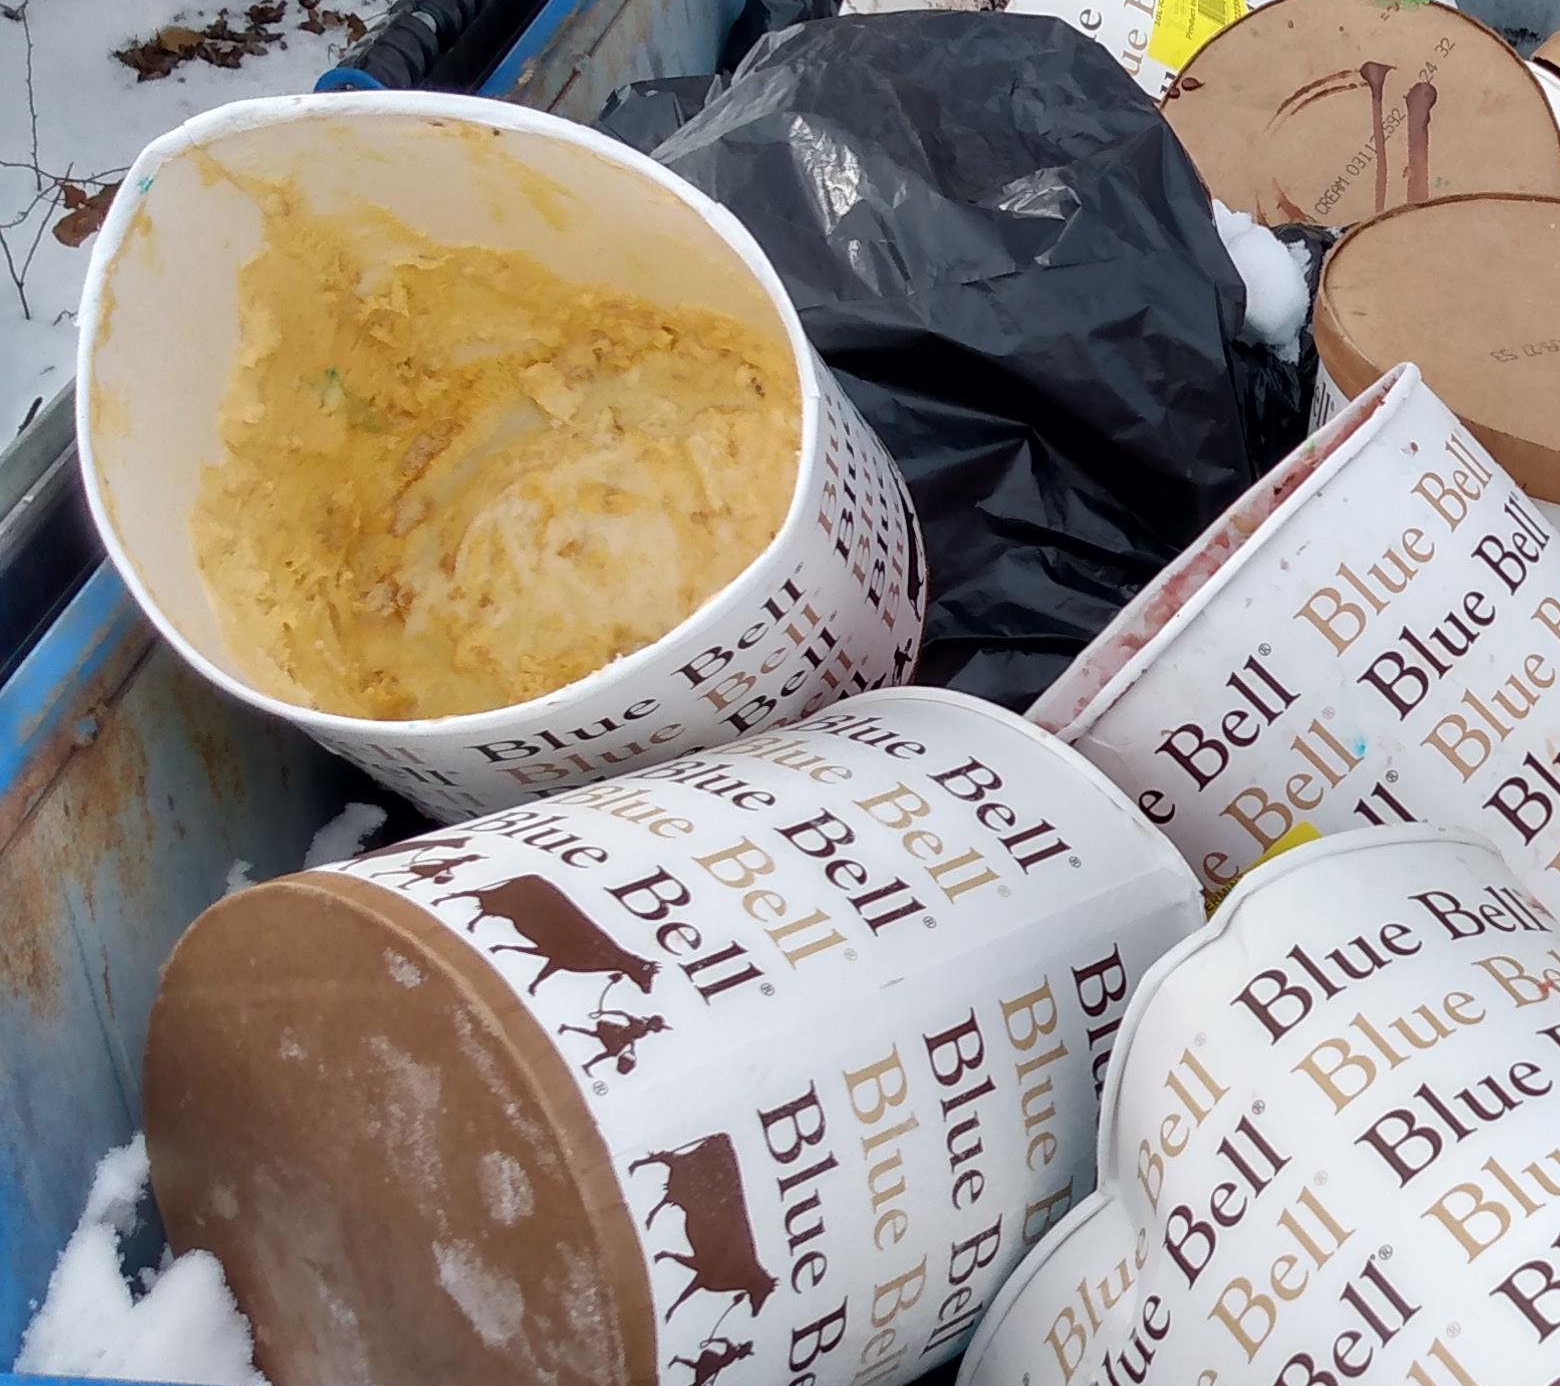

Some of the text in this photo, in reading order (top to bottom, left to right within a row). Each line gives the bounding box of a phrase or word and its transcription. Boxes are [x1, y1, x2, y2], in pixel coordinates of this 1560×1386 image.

[1121, 28, 1148, 78] ue
[1314, 176, 1350, 215] CREAM
[1346, 108, 1406, 177] 0311592
[1434, 37, 1456, 58] 32
[1294, 433, 1494, 657] Blue Bell
[1357, 497, 1551, 721] Blue Bell
[464, 578, 806, 763] Blue Bell
[497, 722, 687, 785] Blue
[698, 604, 820, 713] Bell
[720, 627, 839, 736] Bell
[1155, 652, 1301, 792] Bell
[1420, 649, 1556, 783] Blue
[627, 760, 776, 811] Blue
[774, 808, 929, 938] Bell
[708, 737, 853, 785] Blue
[853, 782, 1001, 905] Bell
[791, 714, 926, 760] Blue
[926, 756, 1073, 875] Bell
[1219, 718, 1364, 854] Bell
[457, 811, 766, 1007] Blue Bell
[550, 784, 849, 970] Blue Bell
[1071, 942, 1127, 1101] Blu
[1232, 887, 1553, 1046] Blue Bell
[1292, 990, 1487, 1115] Blue
[842, 1044, 920, 1252] Blue
[999, 974, 1073, 1174] Blue
[1136, 1042, 1231, 1211] Bell
[1353, 1059, 1553, 1189] Blue
[757, 1080, 838, 1295] Blue
[920, 1007, 1003, 1360] Blue Bell
[1162, 1114, 1293, 1289] Bell
[1043, 1225, 1149, 1386] Blue
[1208, 1184, 1356, 1363] Bell
